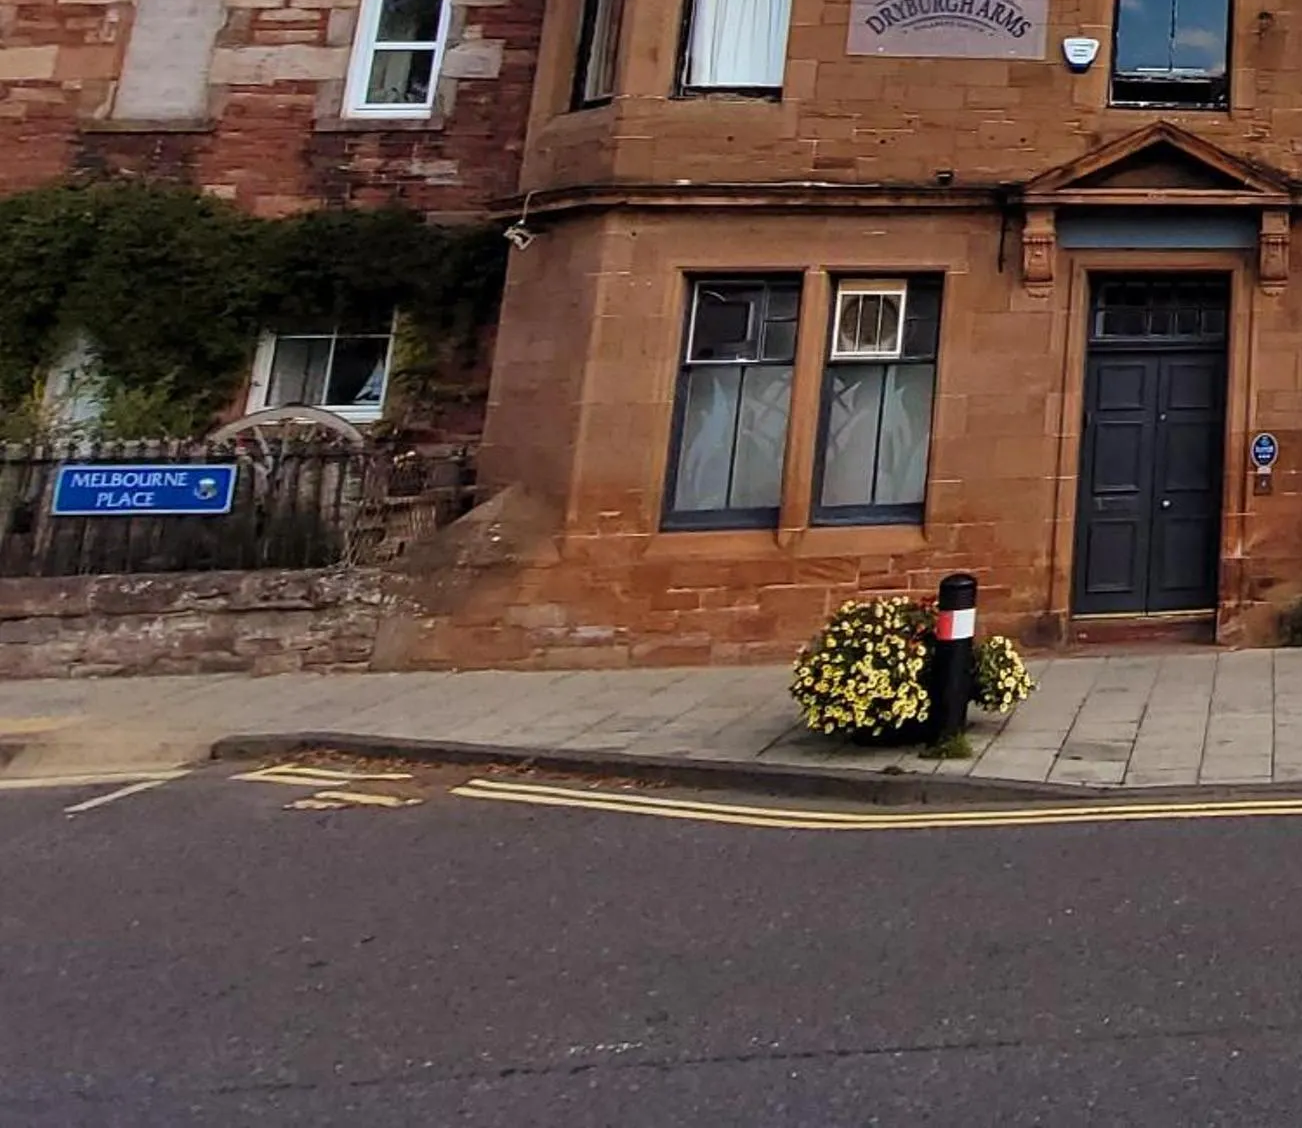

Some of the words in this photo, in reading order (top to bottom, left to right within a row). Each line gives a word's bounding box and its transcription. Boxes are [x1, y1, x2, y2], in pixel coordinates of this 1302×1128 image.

[976, 0, 1032, 39] ARMS
[70, 472, 188, 488] MELBOURNE
[95, 492, 155, 508] PLACE
